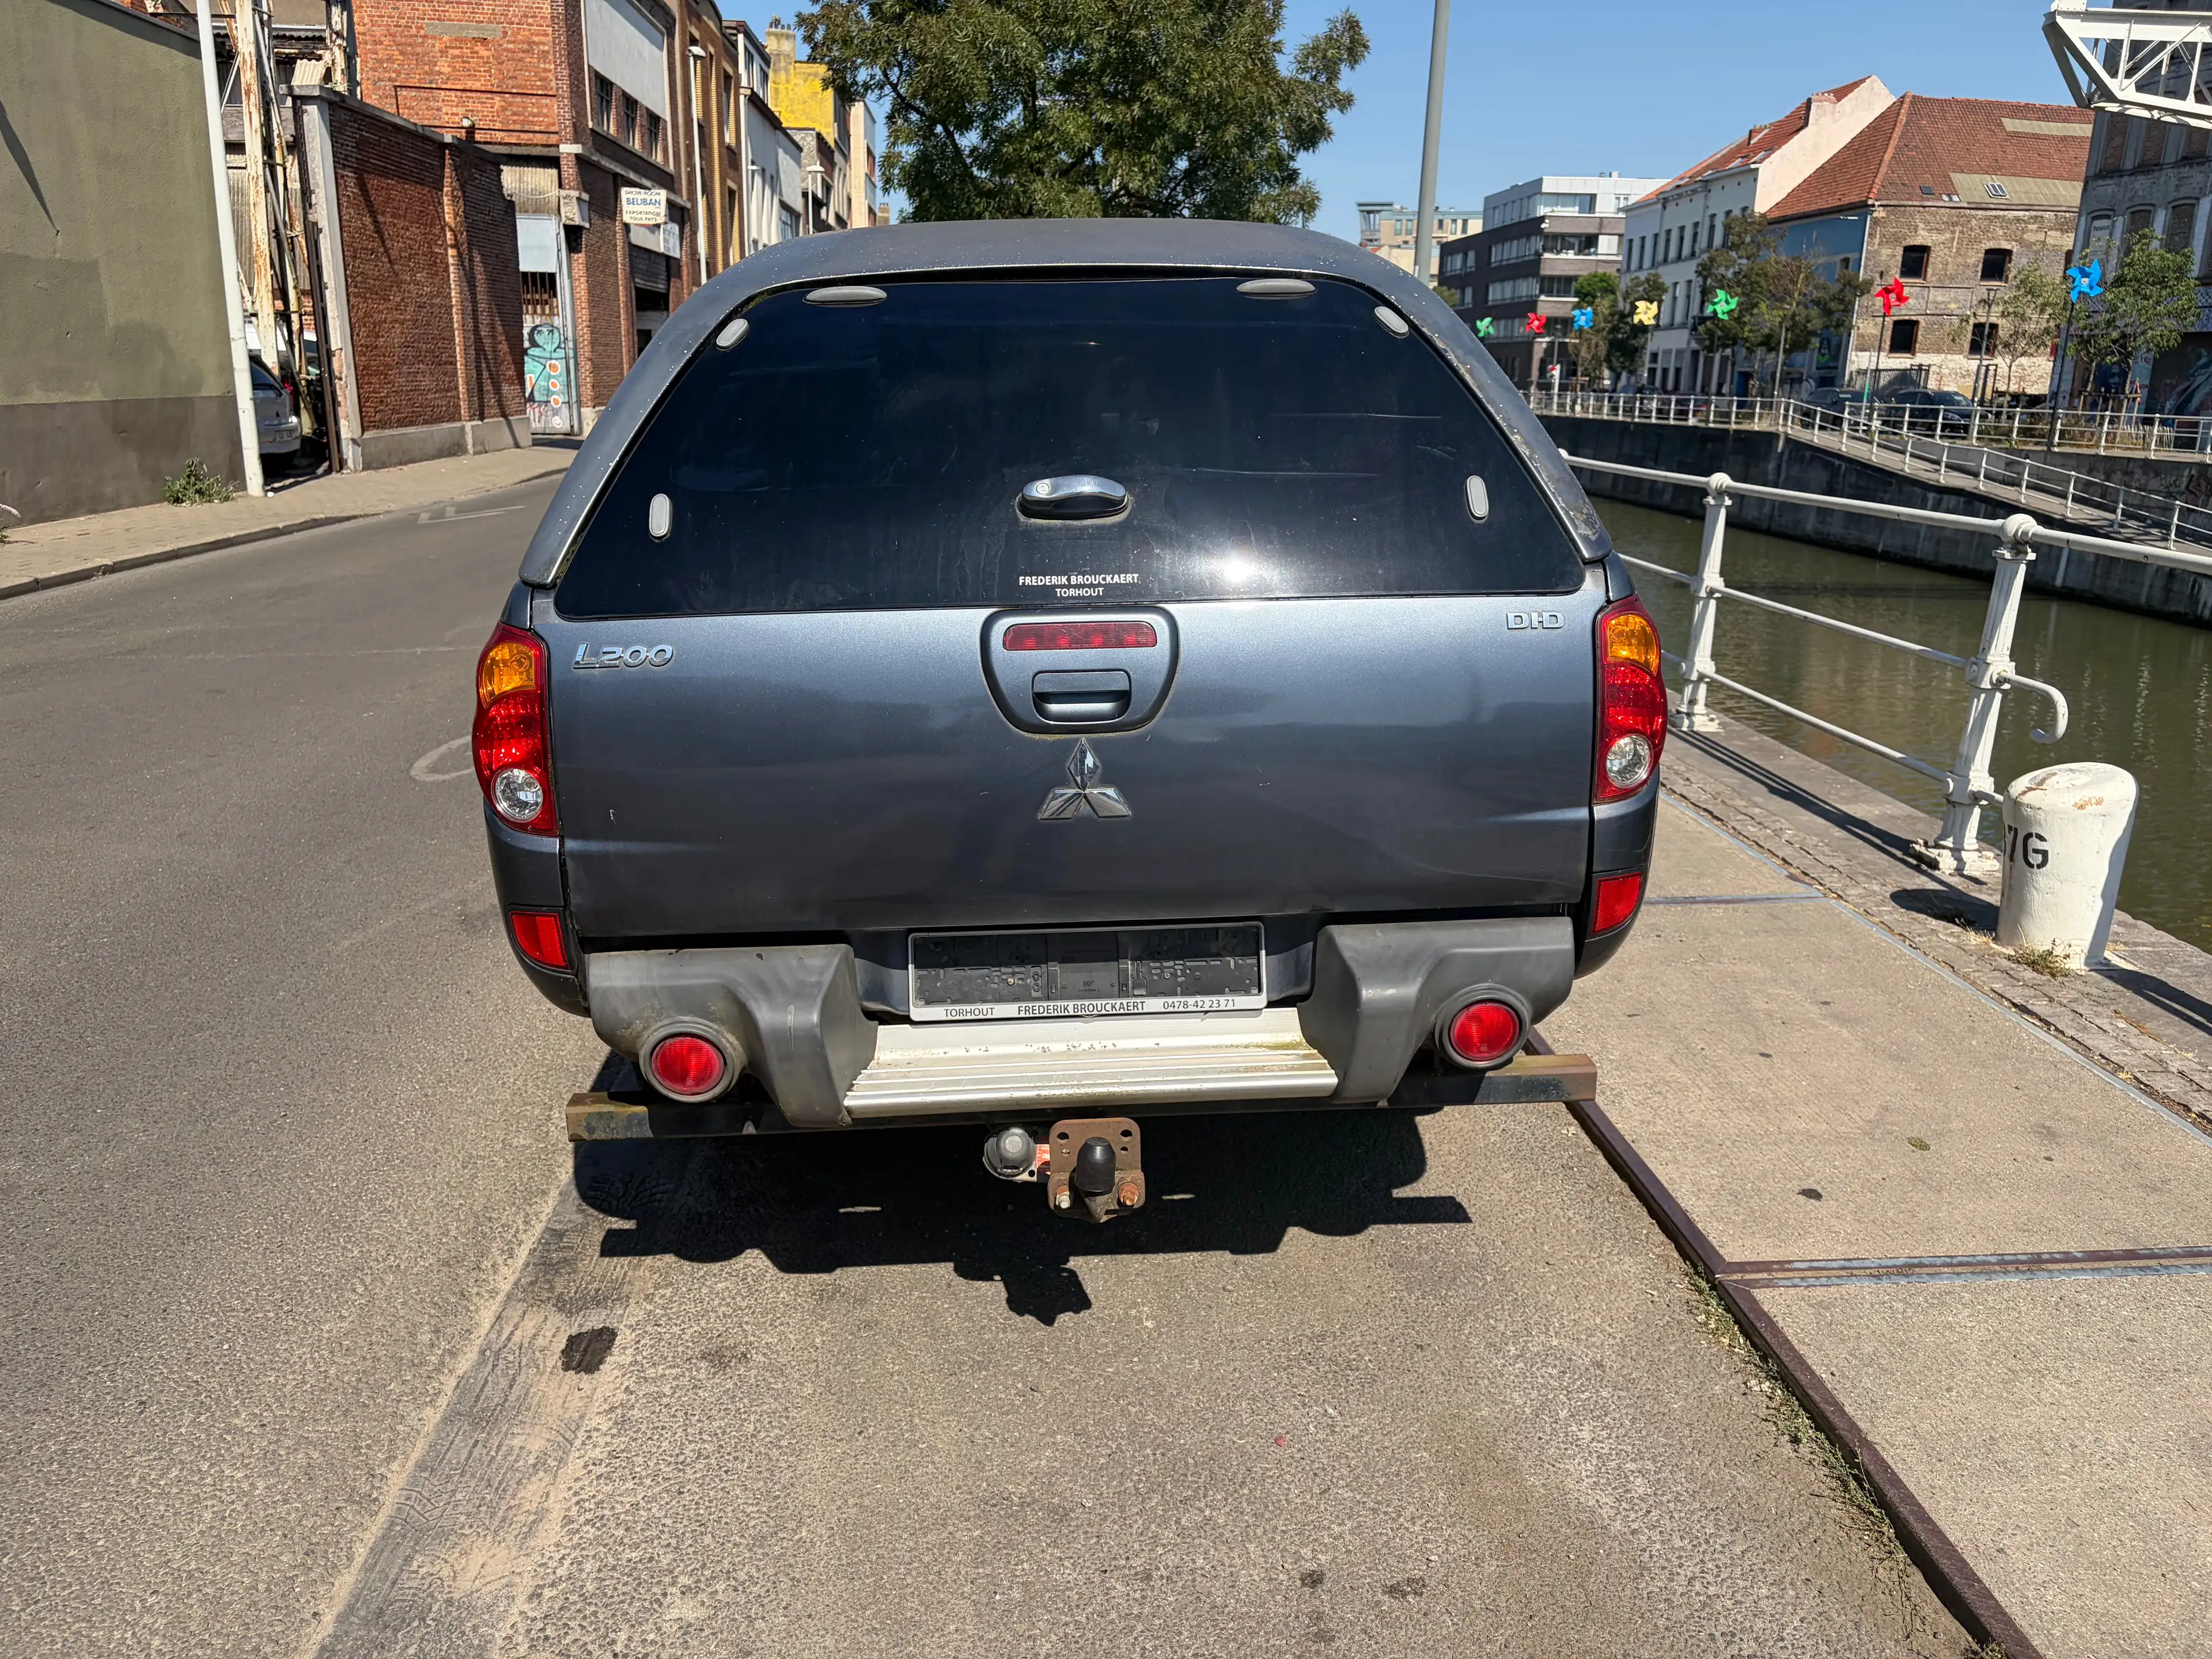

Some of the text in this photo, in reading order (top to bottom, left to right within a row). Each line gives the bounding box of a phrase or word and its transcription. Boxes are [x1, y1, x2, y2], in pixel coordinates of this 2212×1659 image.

[1019, 574, 1139, 586] FREDERIK BROUCKAERT
[1055, 588, 1104, 597] TORHOUT
[573, 643, 674, 669] L200
[2003, 821, 2049, 870] 7G
[944, 999, 1236, 1017] TORHOUT FREDERIK BROUCKAERT 0478-42 23 71
